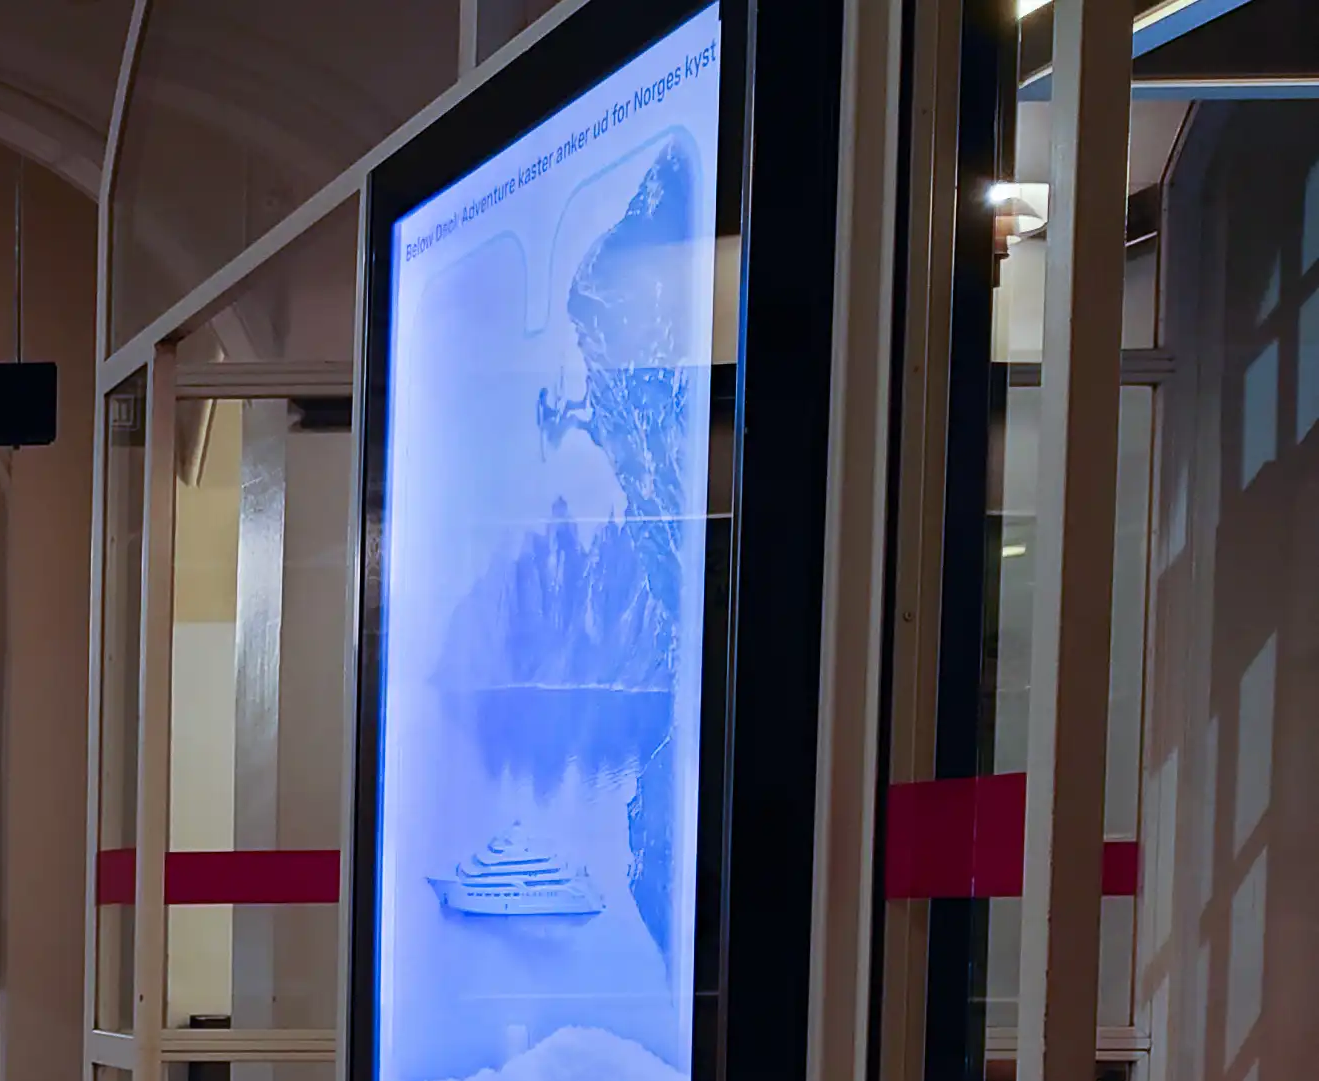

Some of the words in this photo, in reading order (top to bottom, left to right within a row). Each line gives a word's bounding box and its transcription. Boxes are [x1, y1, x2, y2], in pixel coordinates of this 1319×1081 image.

[462, 177, 516, 226] Adventure
[518, 151, 555, 188] kaster
[556, 127, 590, 164] anker
[593, 110, 609, 139] ud
[612, 100, 631, 126] for
[634, 66, 681, 112] Norges
[685, 38, 717, 79] kyst
